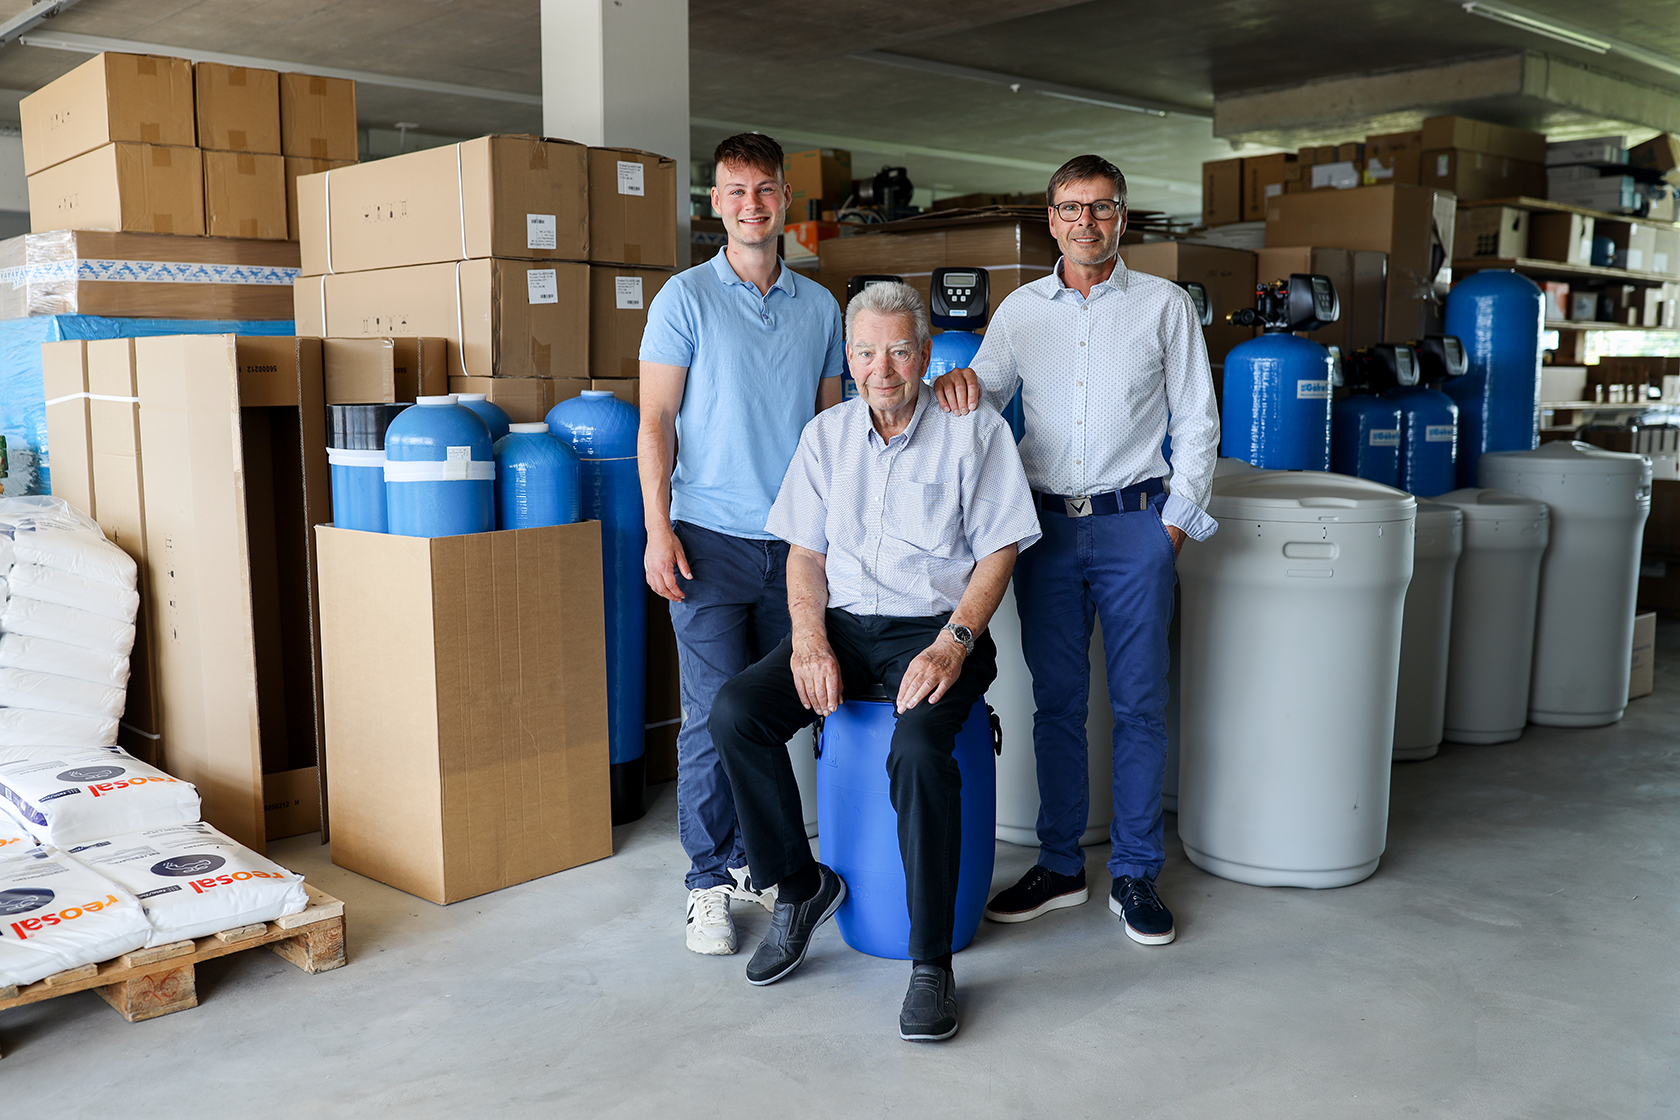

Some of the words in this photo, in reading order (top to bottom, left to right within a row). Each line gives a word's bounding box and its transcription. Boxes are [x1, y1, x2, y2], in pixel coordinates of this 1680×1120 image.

[87, 776, 178, 797] reosal
[188, 870, 284, 894] reosal
[10, 894, 119, 940] reosal
